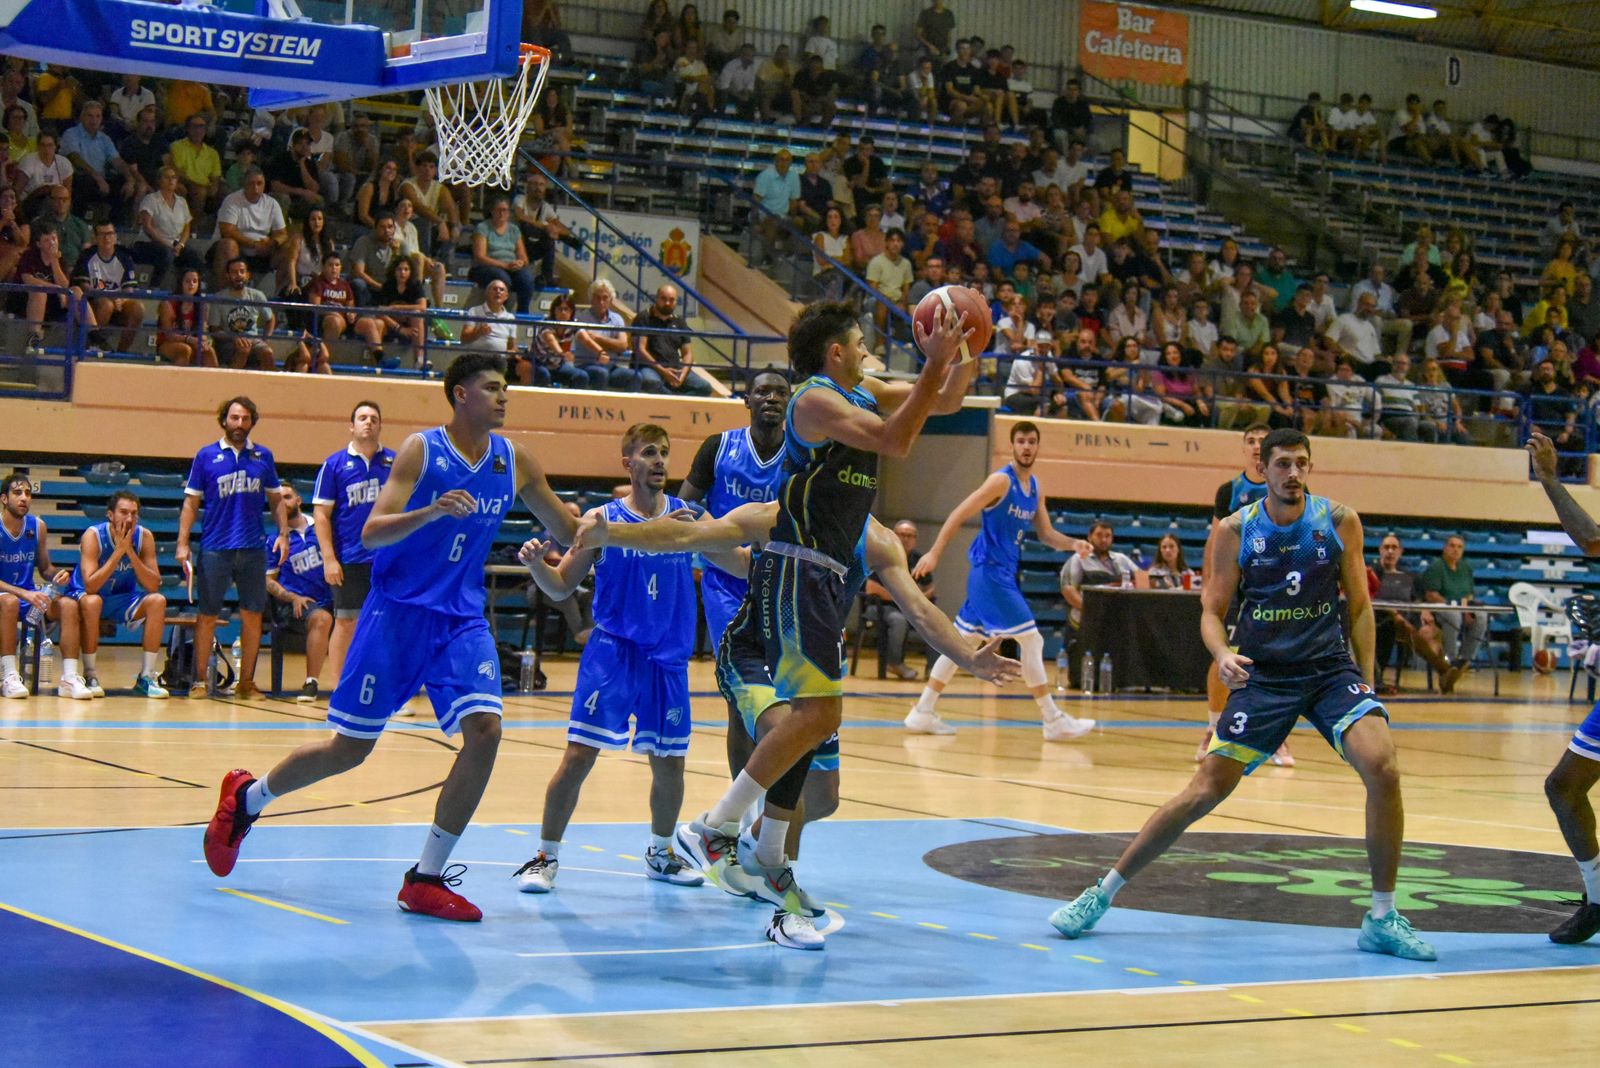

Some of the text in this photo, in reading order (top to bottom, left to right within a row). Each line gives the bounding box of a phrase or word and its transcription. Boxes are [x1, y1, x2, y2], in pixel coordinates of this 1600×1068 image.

[1117, 7, 1155, 34] Bar
[130, 19, 322, 57] SPORT SYSTEM
[1085, 30, 1183, 65] Cafeteria
[1449, 56, 1460, 86] D
[558, 405, 626, 422] PRENSA
[690, 411, 714, 424] TV
[1075, 433, 1131, 449] PRENSA
[1184, 440, 1200, 453] TV
[218, 476, 261, 499] HUELVA
[837, 465, 877, 490] dame
[448, 533, 467, 562] 6
[647, 573, 659, 601] 4
[1286, 570, 1302, 596] 3
[762, 558, 774, 639] damex.io
[1252, 600, 1331, 621] damex.io
[1227, 625, 1237, 641] 7
[359, 673, 376, 705] 6
[584, 689, 600, 716] 4
[1229, 711, 1249, 735] 3
